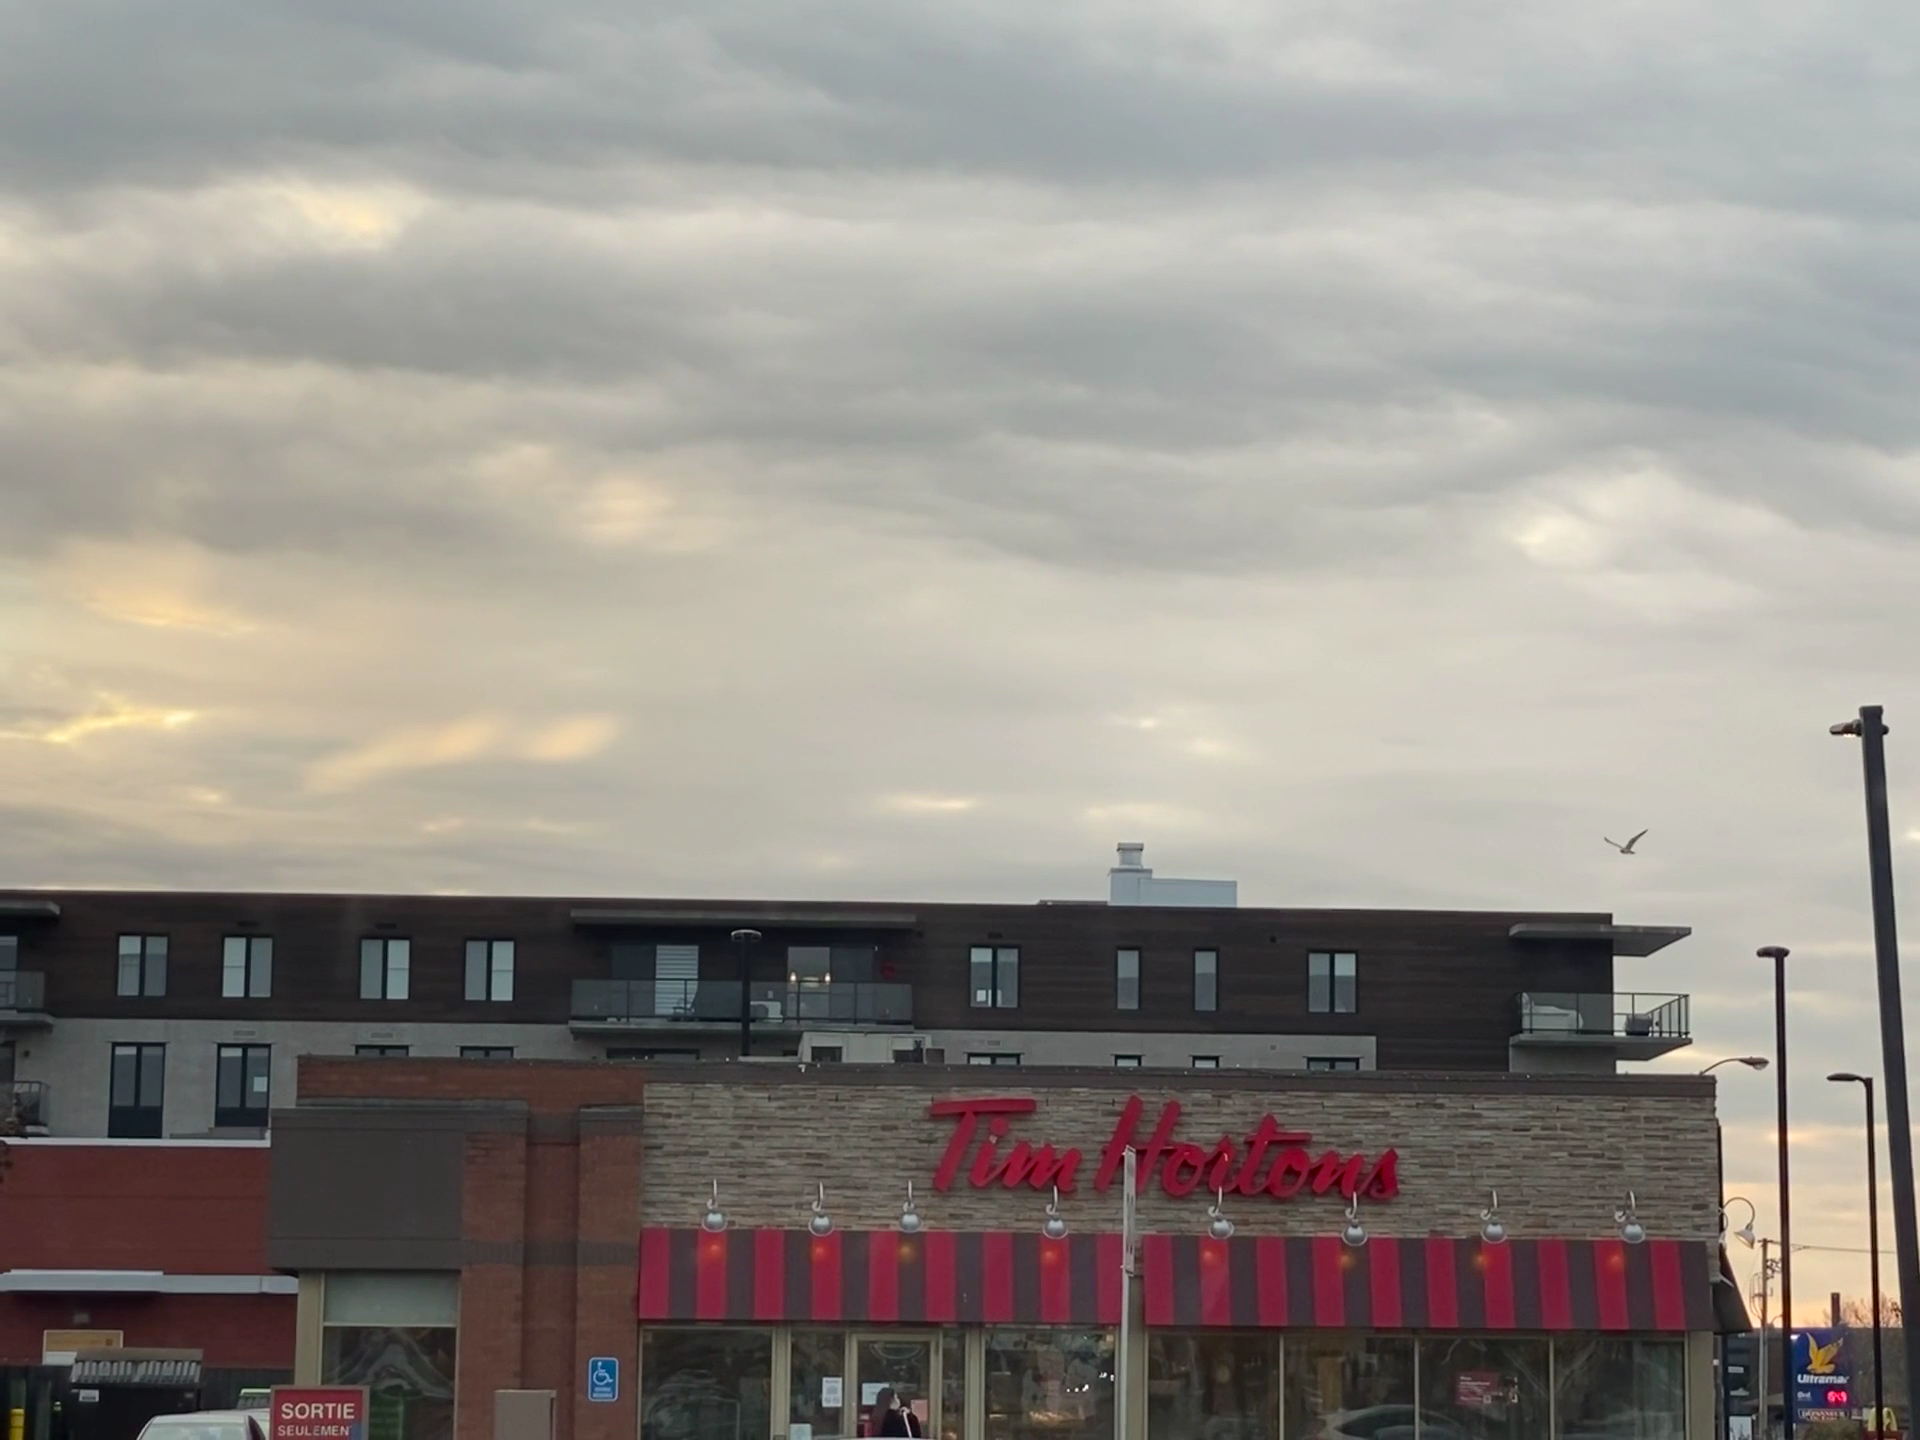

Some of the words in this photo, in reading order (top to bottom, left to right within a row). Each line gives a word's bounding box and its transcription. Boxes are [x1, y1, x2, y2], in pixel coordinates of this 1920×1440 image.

[929, 1097, 1082, 1193] Tim
[1094, 1094, 1400, 1200] Hortons
[1797, 1374, 1850, 1384] Ultramar
[281, 1402, 355, 1419] SORTIE
[278, 1425, 353, 1436] SEULEMEN
